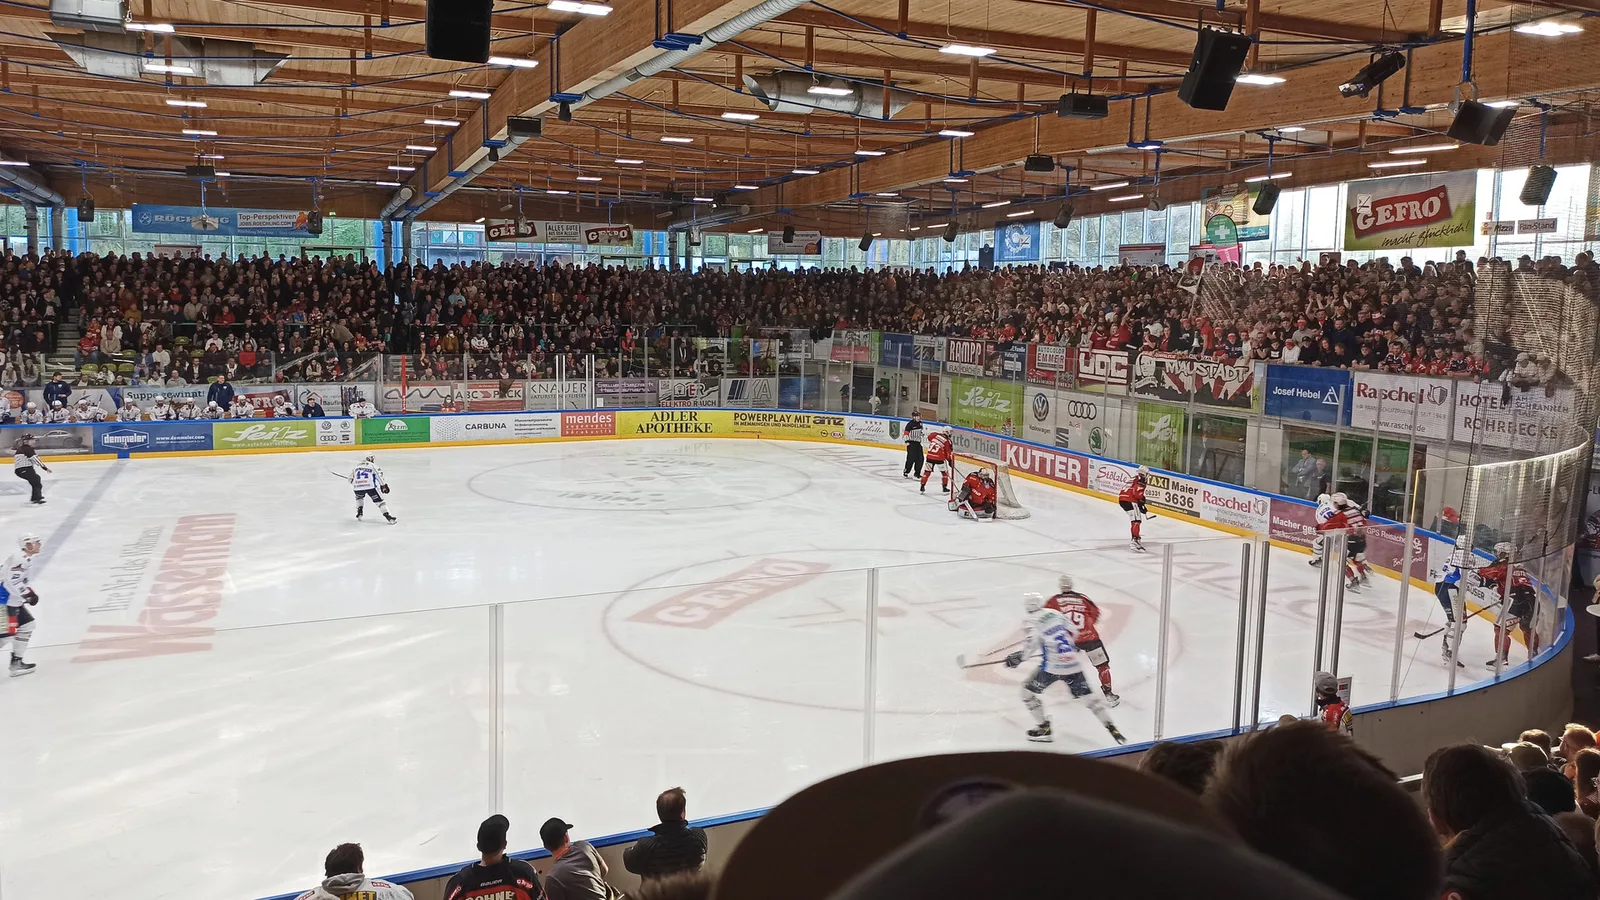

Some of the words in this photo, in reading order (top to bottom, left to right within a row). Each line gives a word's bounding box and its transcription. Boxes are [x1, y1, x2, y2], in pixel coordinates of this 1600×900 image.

[238, 213, 297, 221] Top-Perspektiven
[1357, 196, 1441, 230] GEFRO
[1494, 224, 1513, 232] Pizza
[1519, 221, 1555, 230] Fan-Stand
[1381, 234, 1417, 248] macht
[1417, 220, 1470, 247] glücklich!
[949, 341, 982, 364] RAMPP
[1037, 353, 1065, 364] EMMER
[127, 392, 159, 401] Suppe
[493, 389, 522, 398] PCK
[1272, 386, 1295, 396] Josef
[1296, 389, 1321, 399] Hebel
[1356, 382, 1425, 404] Raschel
[1460, 394, 1506, 409] HOTEL
[565, 413, 612, 424] mendes
[650, 411, 698, 422] ADLER
[733, 412, 792, 423] POWERPLAY
[794, 415, 811, 424] MIT
[812, 415, 845, 426] amz
[636, 422, 713, 434] APOTHEKE
[103, 433, 147, 444] demmeler
[951, 433, 970, 449] uto
[973, 437, 999, 455] Thiel
[1006, 443, 1081, 483] KUTTER
[1146, 476, 1168, 489] TAXI
[1171, 481, 1198, 495] Maier
[1164, 492, 1194, 509] 3636
[1202, 490, 1252, 513] Raschel
[1272, 516, 1301, 530] Macher
[1366, 527, 1381, 537] GPS
[69, 512, 238, 663] Wassermann
[480, 879, 503, 887] BAUER
